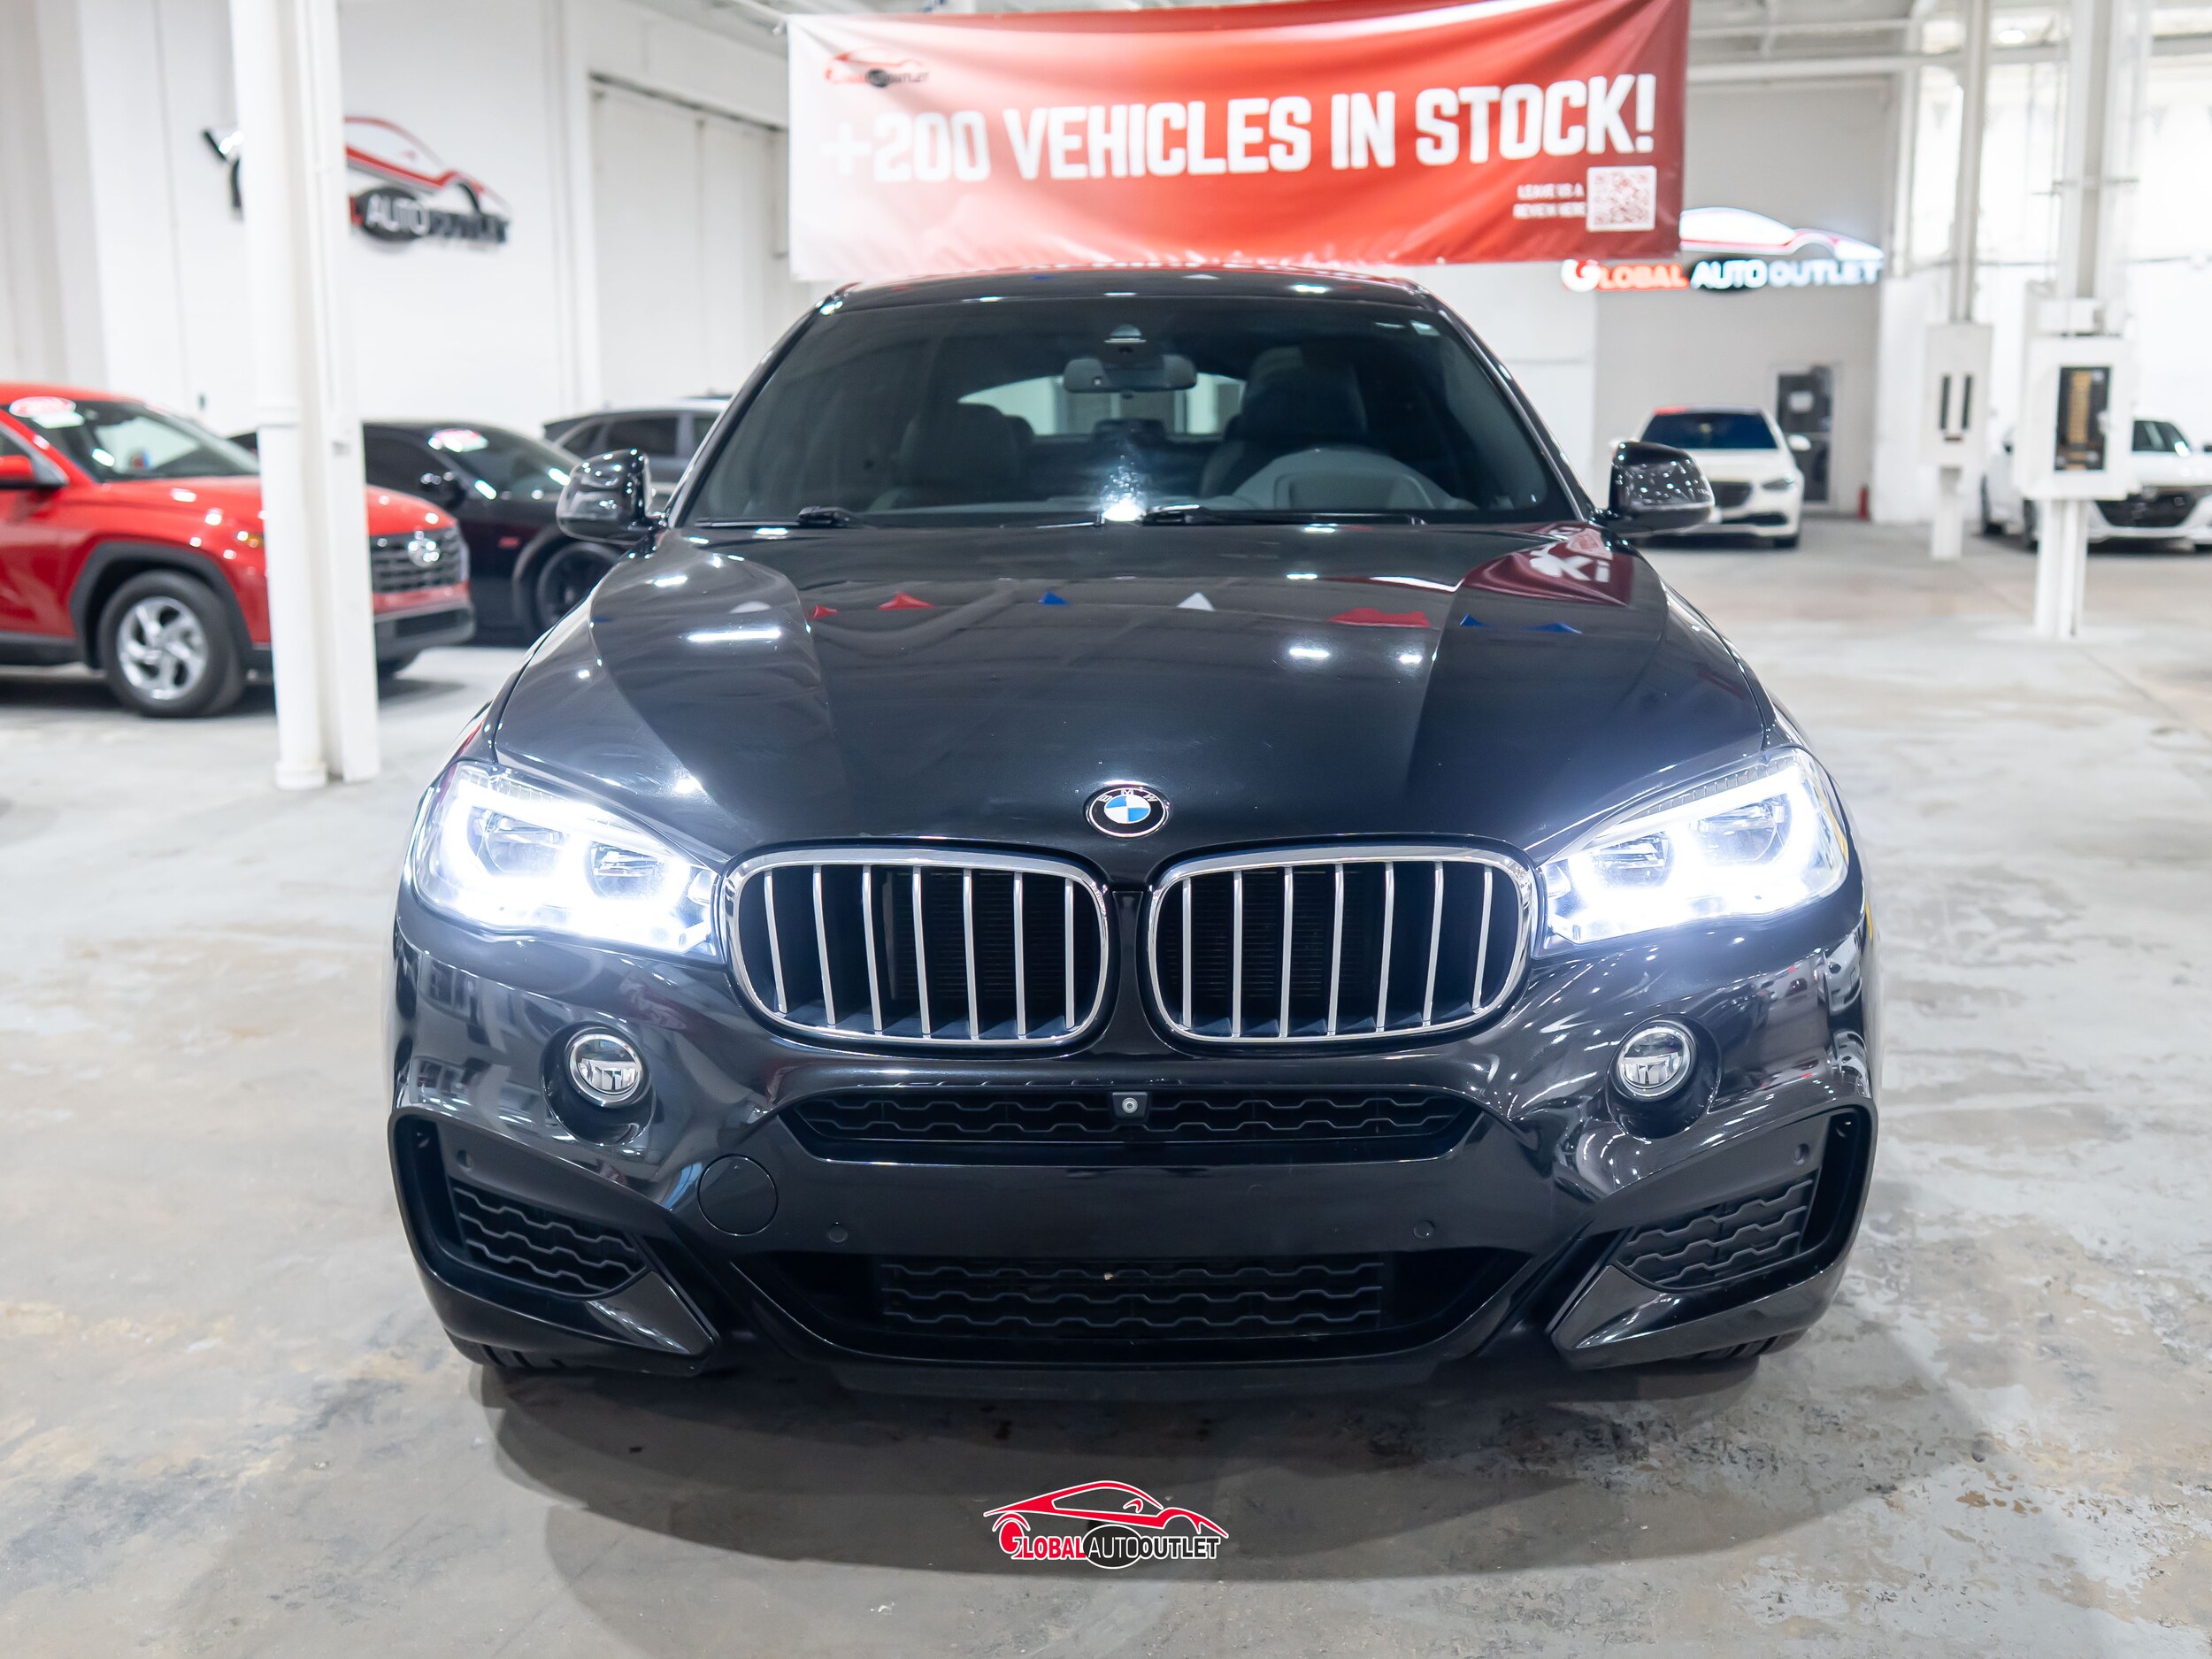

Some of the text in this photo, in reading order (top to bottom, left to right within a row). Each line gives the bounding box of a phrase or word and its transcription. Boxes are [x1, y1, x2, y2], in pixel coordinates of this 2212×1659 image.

[818, 73, 1657, 182] +200 VEHICLES IN STOCK!
[1561, 258, 1882, 292] GLOBAL AUTO OUTLET
[1097, 789, 1158, 803] BMW
